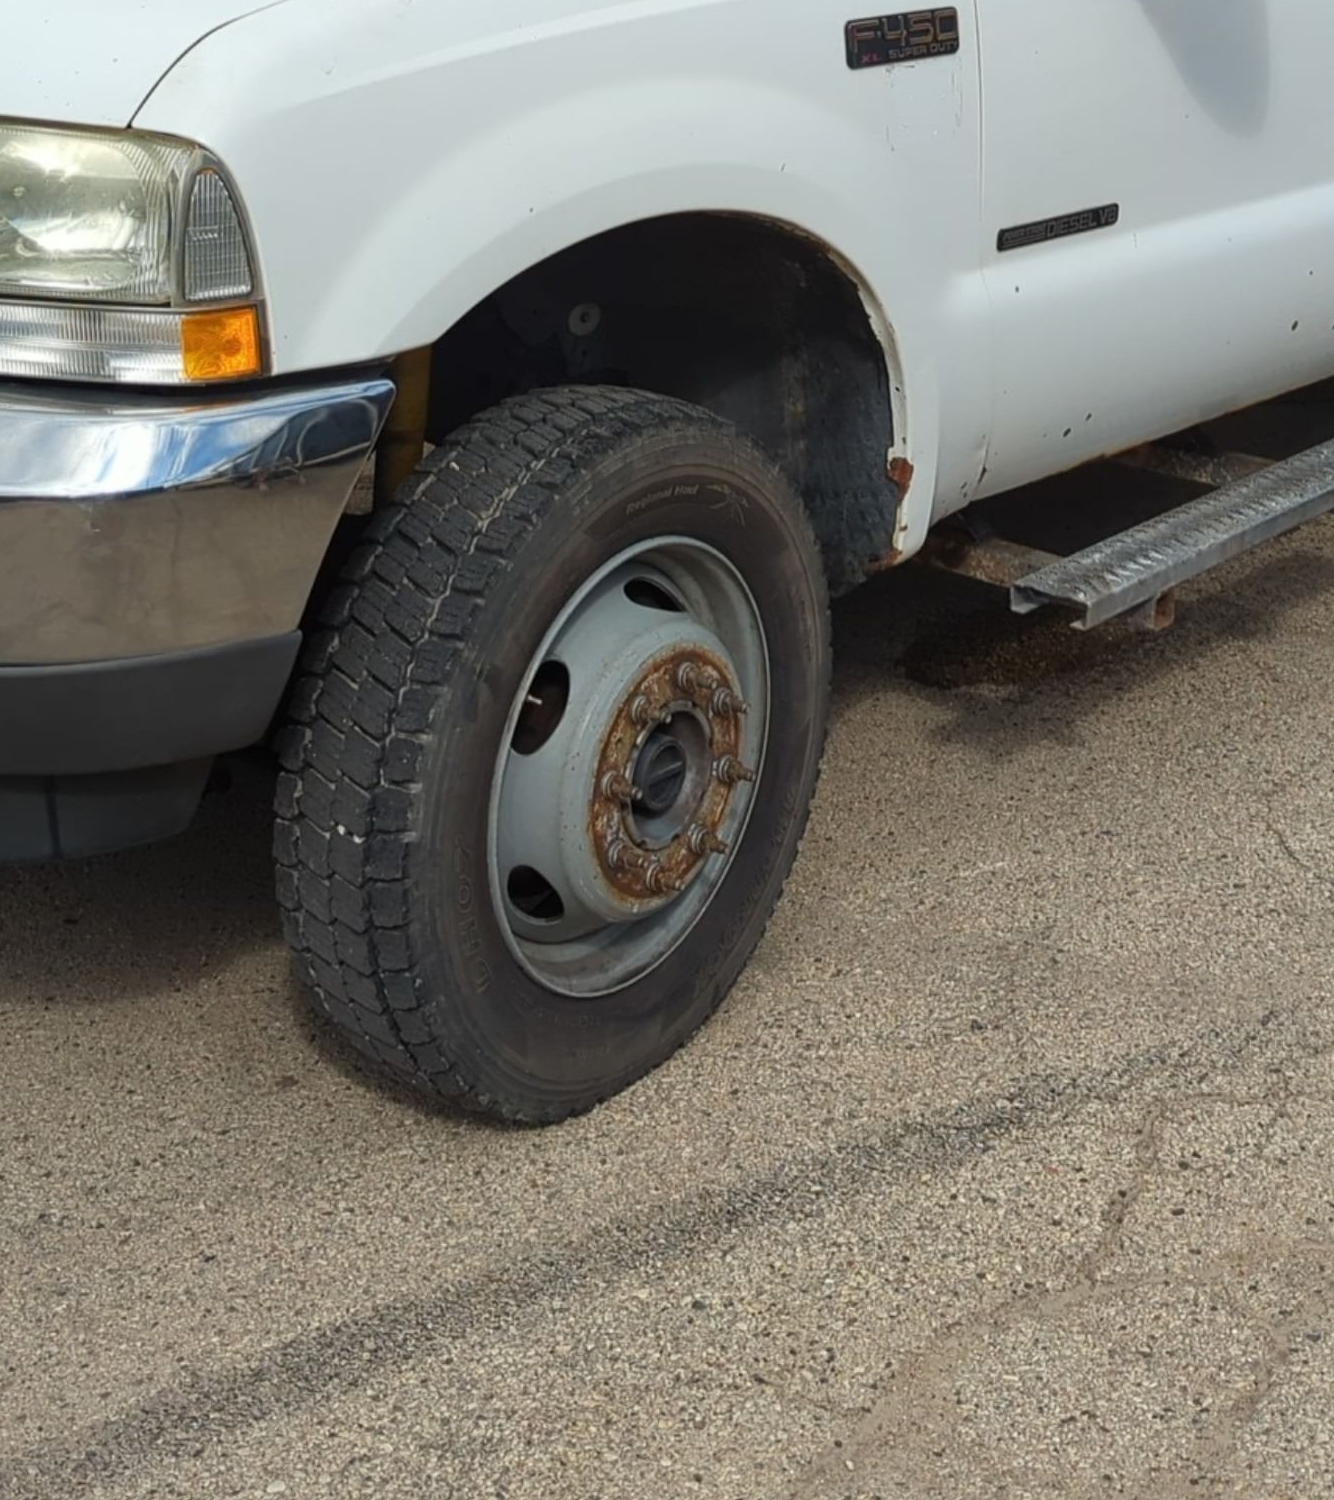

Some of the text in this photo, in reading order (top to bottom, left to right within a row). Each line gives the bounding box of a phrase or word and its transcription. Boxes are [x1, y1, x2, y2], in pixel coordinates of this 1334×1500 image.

[889, 40, 958, 60] SUPER DUTY
[1047, 213, 1098, 238] DIESEL
